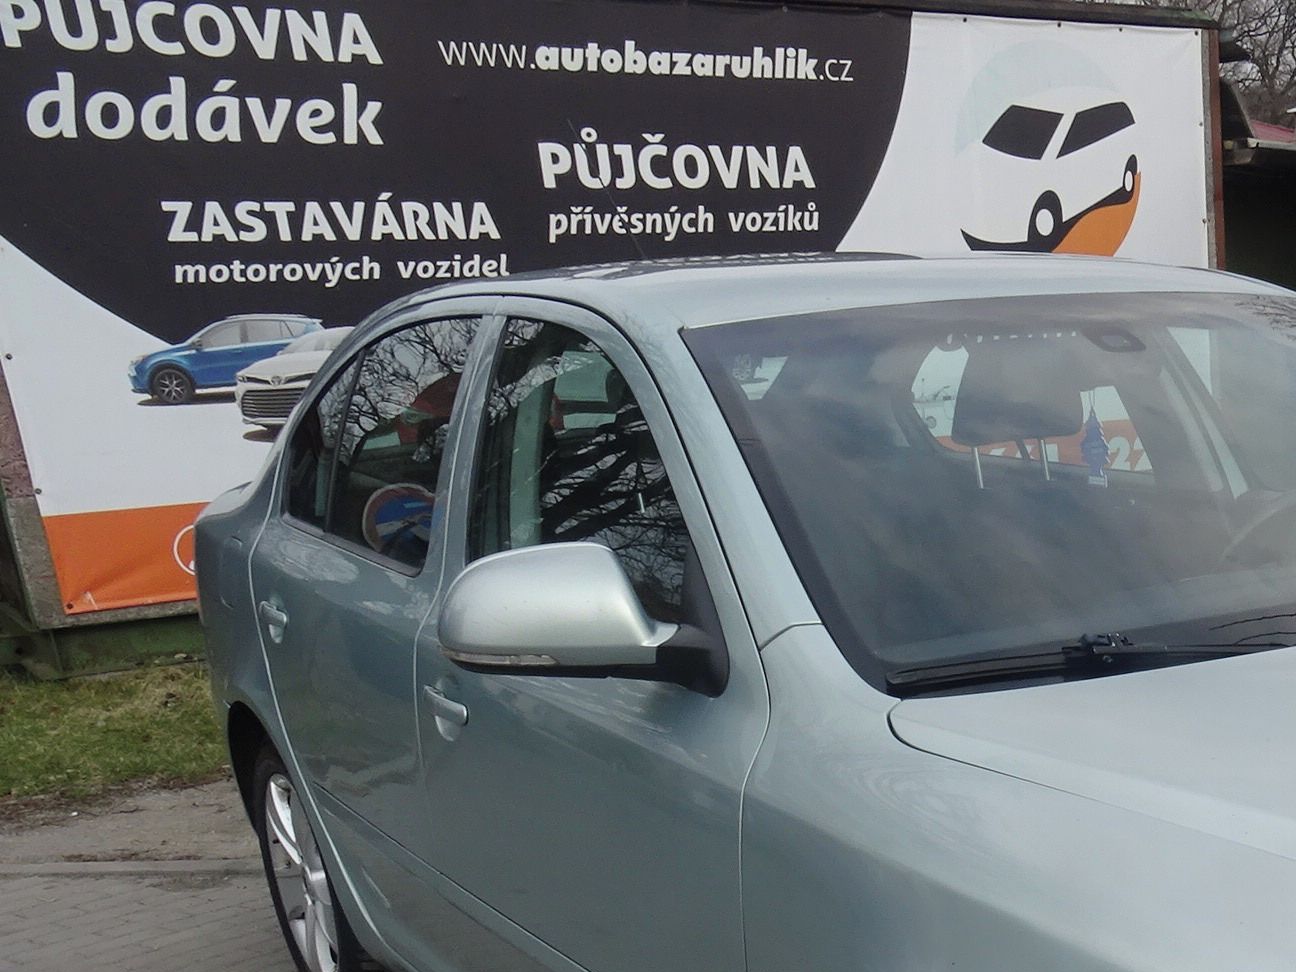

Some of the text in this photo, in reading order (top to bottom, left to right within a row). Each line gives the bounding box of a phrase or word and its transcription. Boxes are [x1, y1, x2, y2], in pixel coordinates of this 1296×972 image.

[438, 40, 853, 81] www.autobazaruhlik.cz
[26, 71, 384, 145] dodávek
[538, 128, 815, 189] PŮJČOVNA
[161, 192, 501, 241] ZASTAVÁRNA
[549, 202, 820, 243] přívěsných vozíků
[175, 254, 510, 287] motorových vozidel
